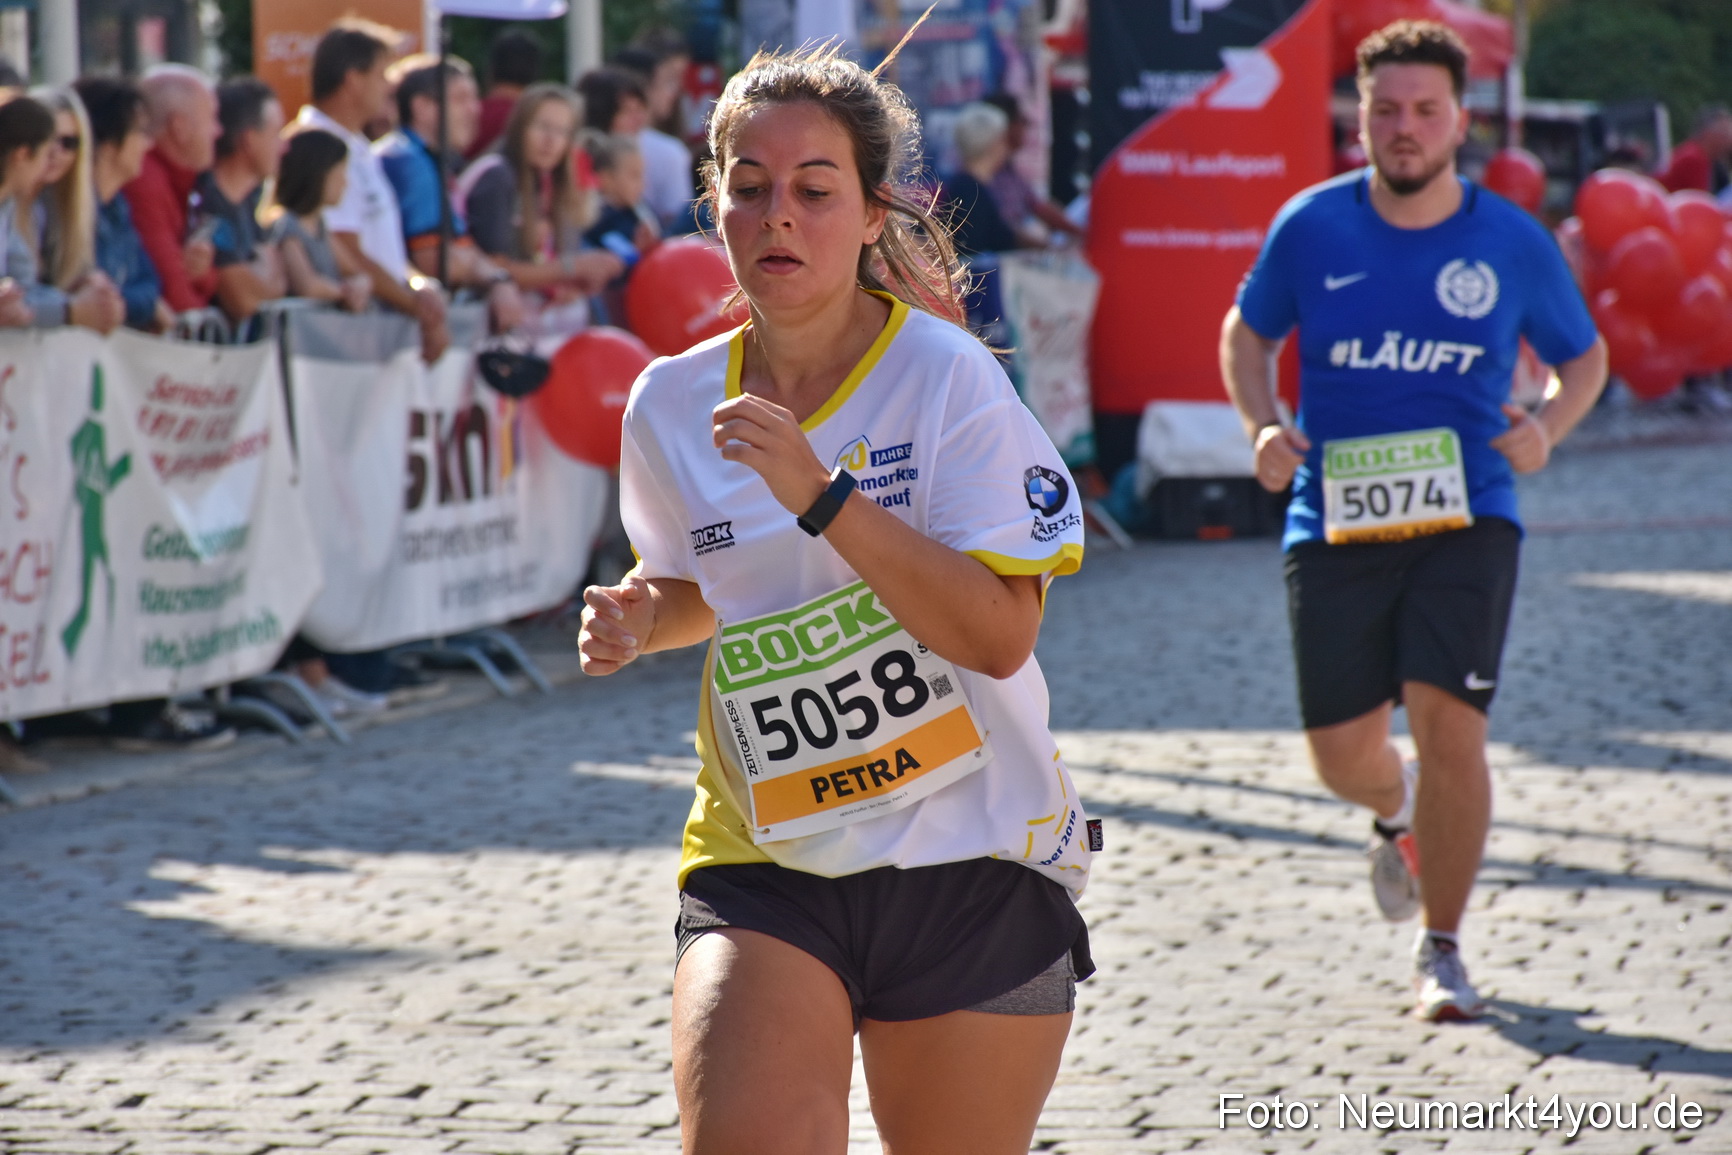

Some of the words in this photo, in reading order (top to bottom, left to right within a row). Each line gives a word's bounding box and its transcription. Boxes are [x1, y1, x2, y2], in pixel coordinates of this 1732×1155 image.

[1330, 331, 1486, 375] #LÄUFT
[874, 445, 912, 466] JAHRE
[1335, 441, 1438, 470] BOCK
[1342, 477, 1447, 520] 5074
[720, 590, 890, 677] BOCK
[750, 650, 930, 761] 5058
[810, 747, 922, 804] PETRA
[1061, 810, 1077, 846] 2019
